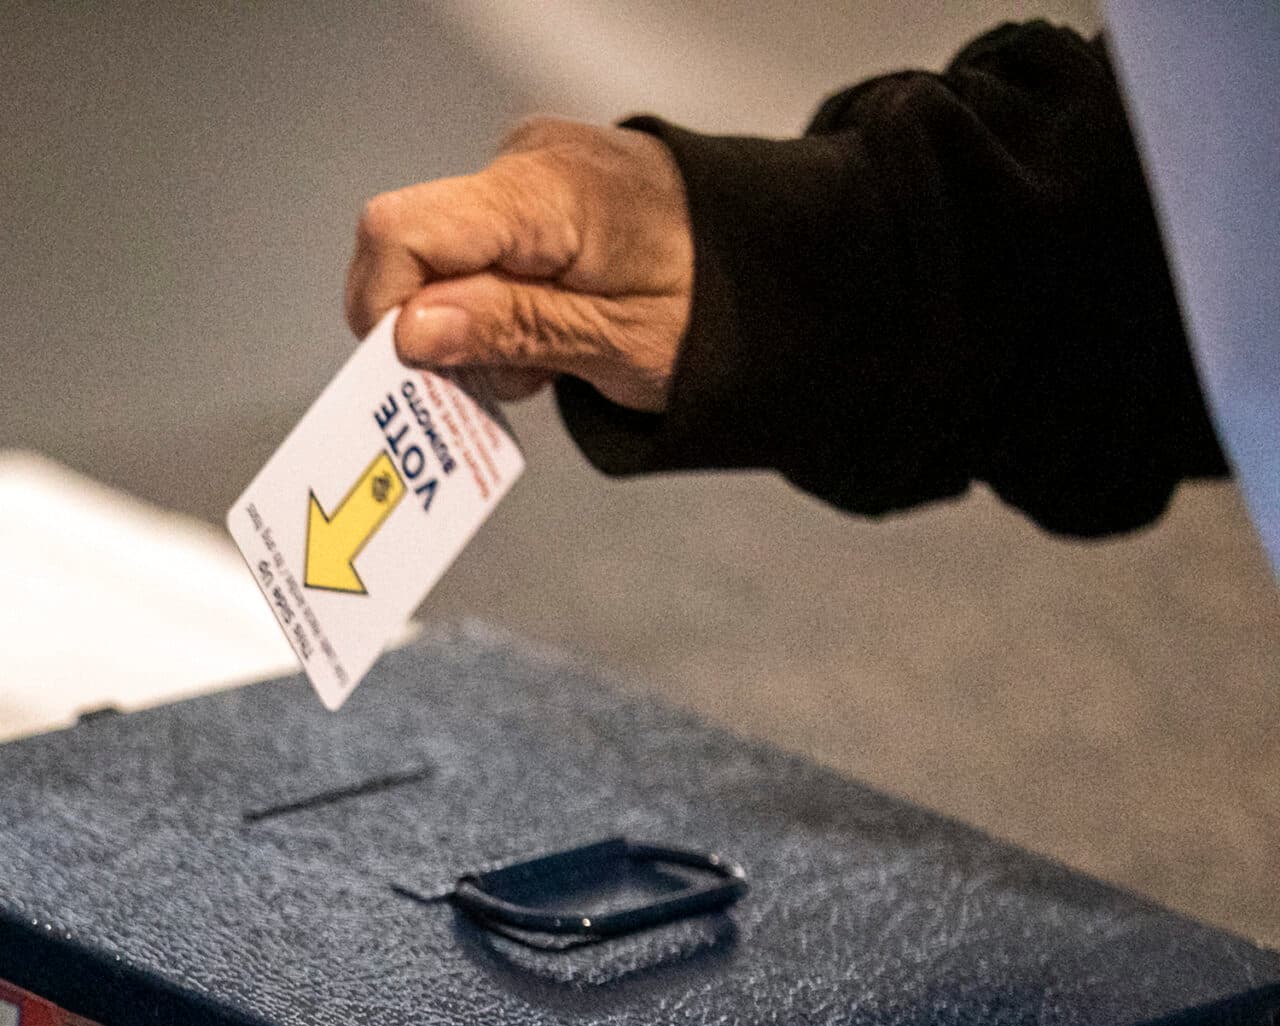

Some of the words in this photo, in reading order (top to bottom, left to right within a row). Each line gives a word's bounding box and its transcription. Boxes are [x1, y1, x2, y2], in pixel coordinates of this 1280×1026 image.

[401, 381, 457, 475] BUMOTO
[372, 393, 439, 512] VOTE
[258, 559, 274, 588] Up
[273, 585, 296, 625] Side
[293, 622, 314, 661] This
